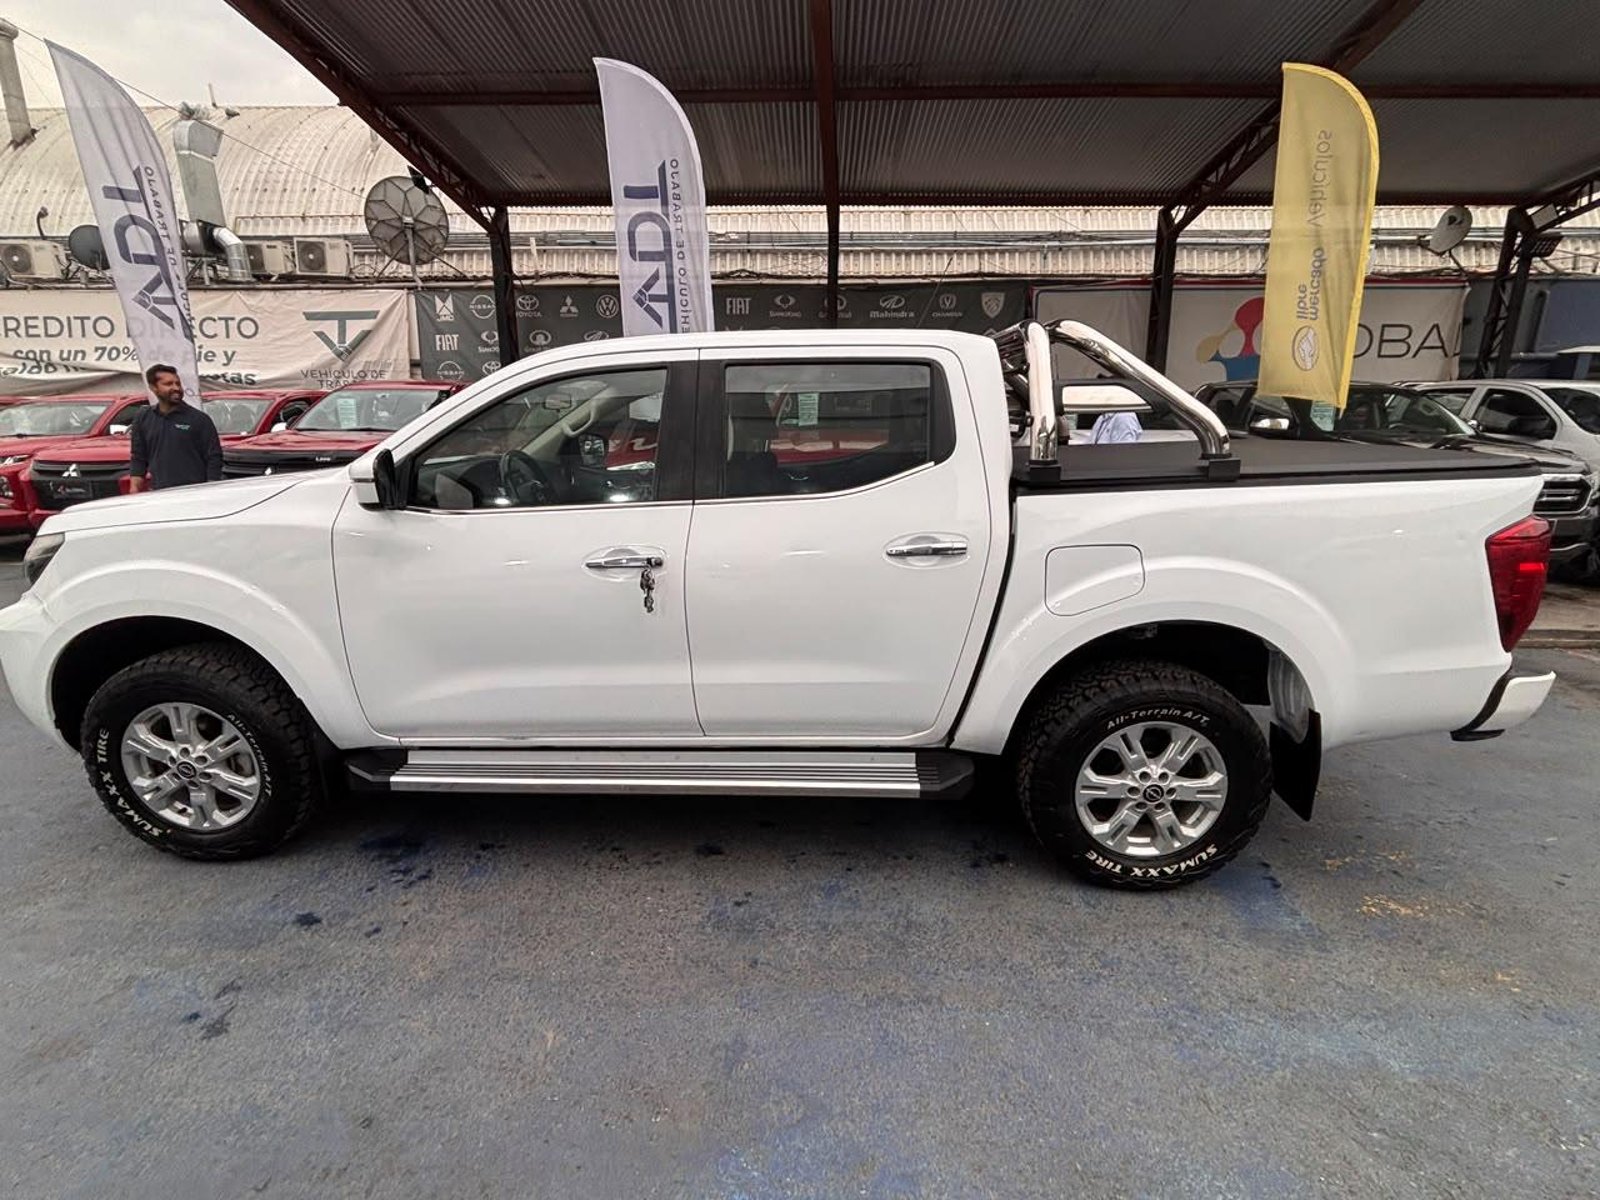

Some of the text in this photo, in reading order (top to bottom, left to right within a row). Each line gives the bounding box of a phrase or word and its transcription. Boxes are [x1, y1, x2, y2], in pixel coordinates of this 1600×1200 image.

[726, 298, 752, 315] FIAT
[870, 310, 915, 318] Mahindra
[0, 315, 115, 338] REDITO
[435, 335, 459, 350] FIAT
[13, 349, 51, 361] con
[59, 349, 86, 361] un
[94, 346, 139, 361] 70%
[223, 350, 236, 366] y
[1107, 708, 1210, 729] All-Terrain A/T
[97, 728, 163, 836] SUMAXX TIRE
[1085, 844, 1218, 877] SUMAXX TIRE
